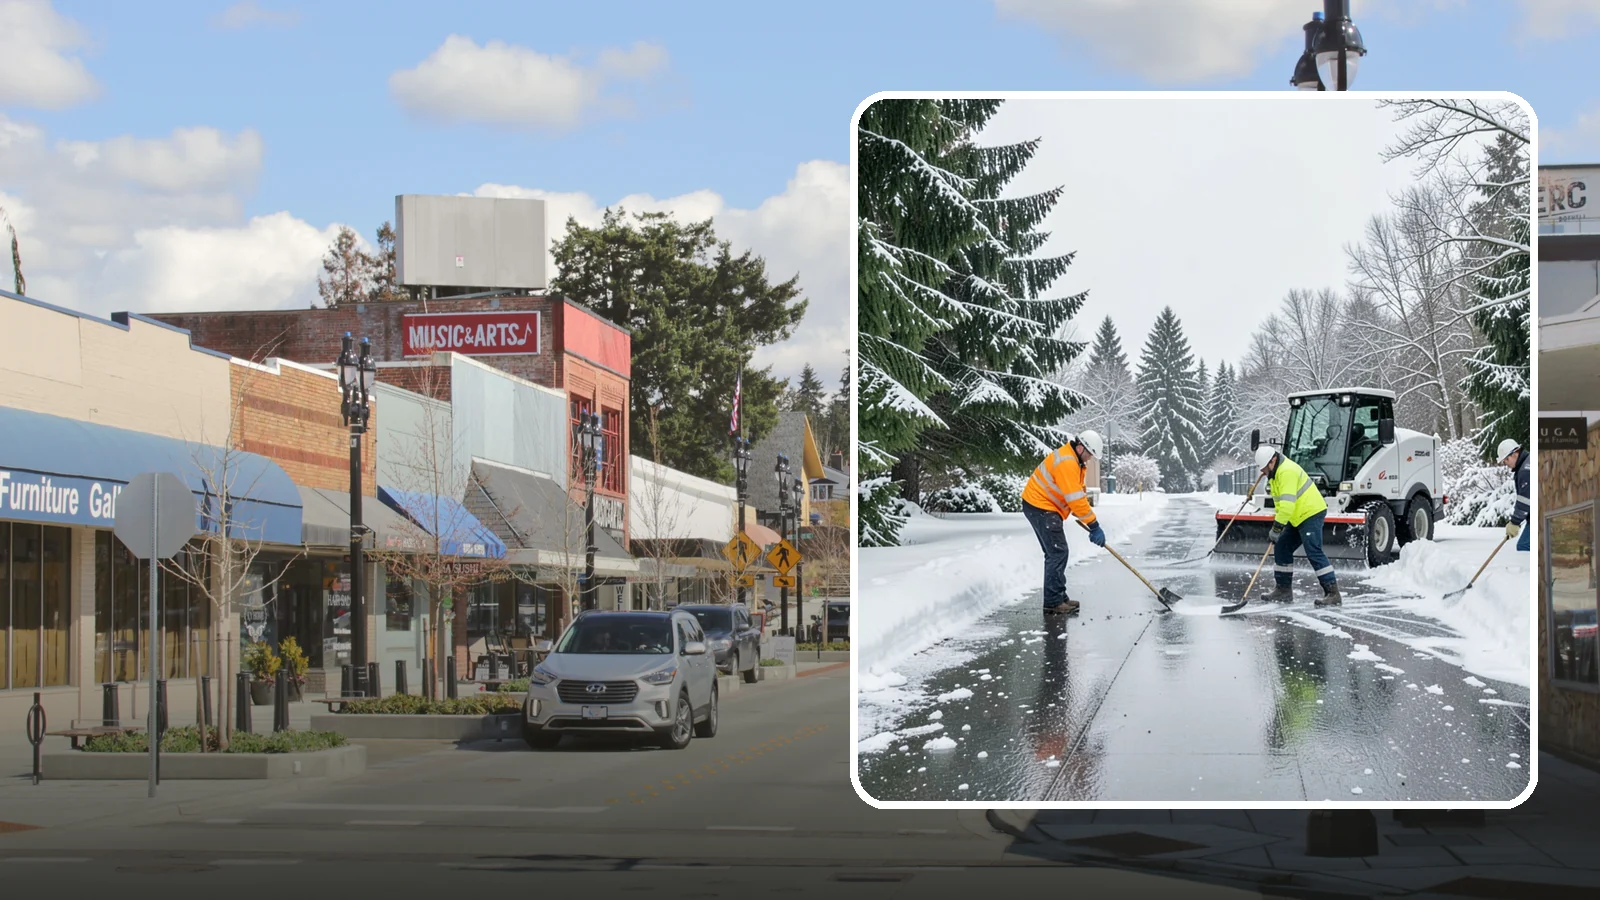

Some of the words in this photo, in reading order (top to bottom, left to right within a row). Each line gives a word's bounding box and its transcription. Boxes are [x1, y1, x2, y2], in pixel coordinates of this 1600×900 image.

[0, 472, 79, 515] Furniture
[90, 482, 122, 519] Gal
[453, 563, 479, 574] SUSHI
